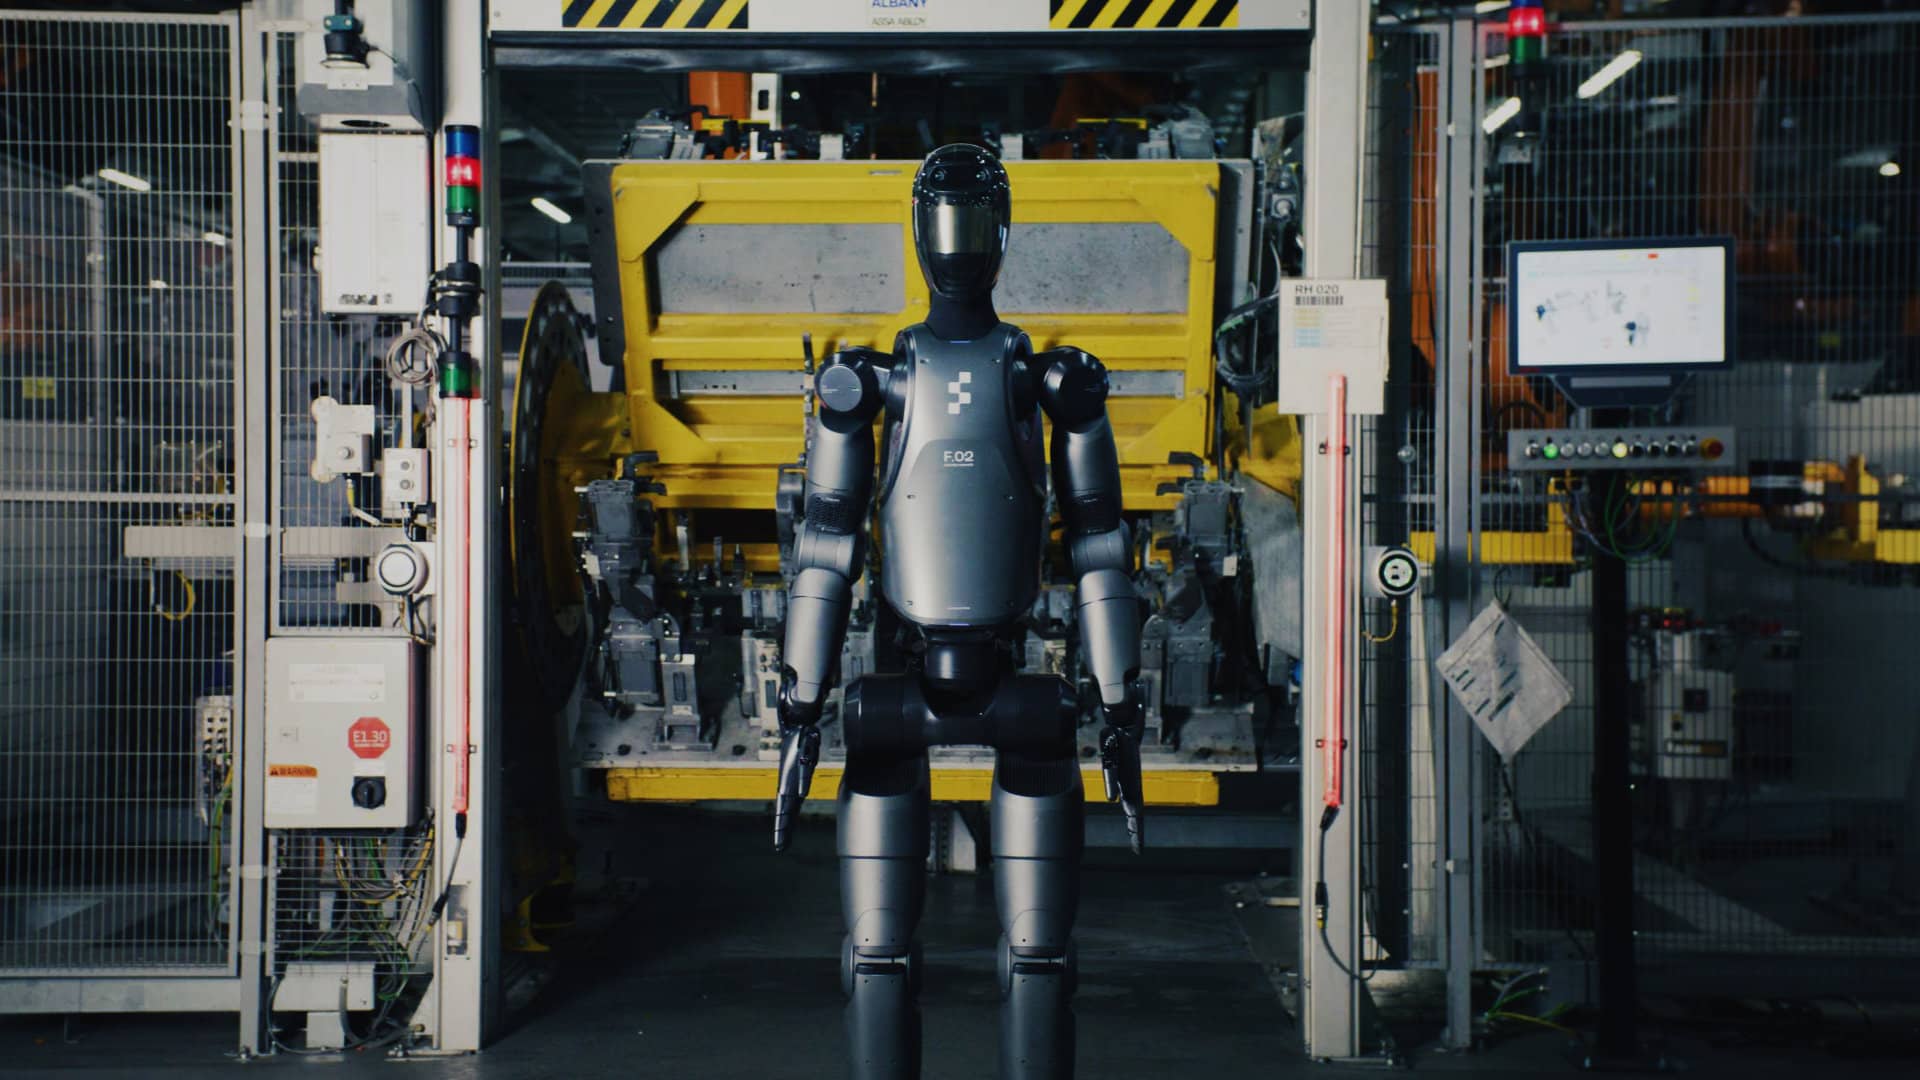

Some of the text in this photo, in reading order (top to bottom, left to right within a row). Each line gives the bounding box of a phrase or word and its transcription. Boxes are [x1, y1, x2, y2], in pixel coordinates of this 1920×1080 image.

[872, 0, 926, 8] ALBANY
[1295, 285, 1340, 294] RH 020
[943, 450, 975, 462] F.02
